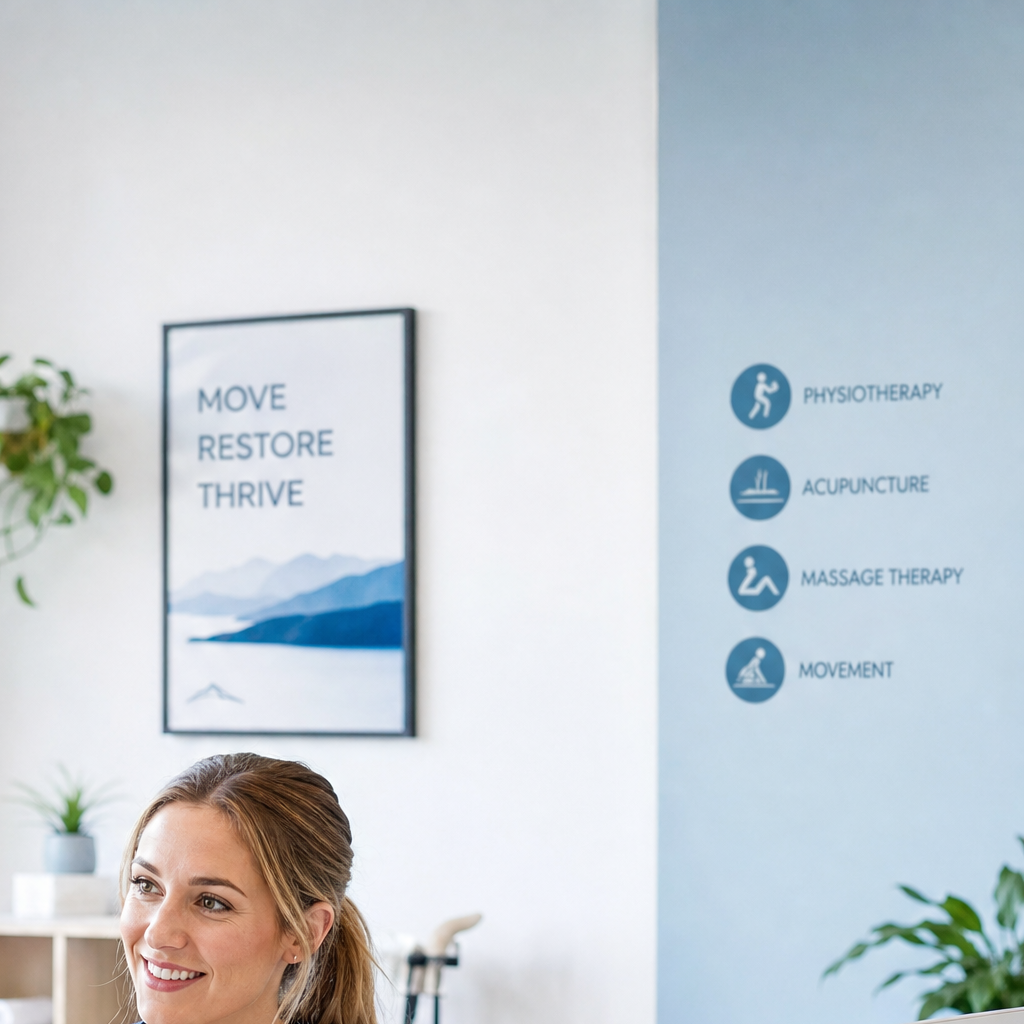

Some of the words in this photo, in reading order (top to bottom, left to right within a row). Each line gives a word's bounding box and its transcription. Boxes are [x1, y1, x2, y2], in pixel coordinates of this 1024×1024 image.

[197, 383, 287, 413] MOVE
[803, 383, 943, 404] PHYSIOTHERAPY
[198, 429, 334, 460] RESTORE
[197, 480, 304, 508] THRIVE
[802, 475, 930, 496] ACUPUNCTURE
[801, 568, 884, 586] MASSAGE
[888, 567, 964, 585] THERAPY
[799, 661, 894, 679] MOVEMENT
